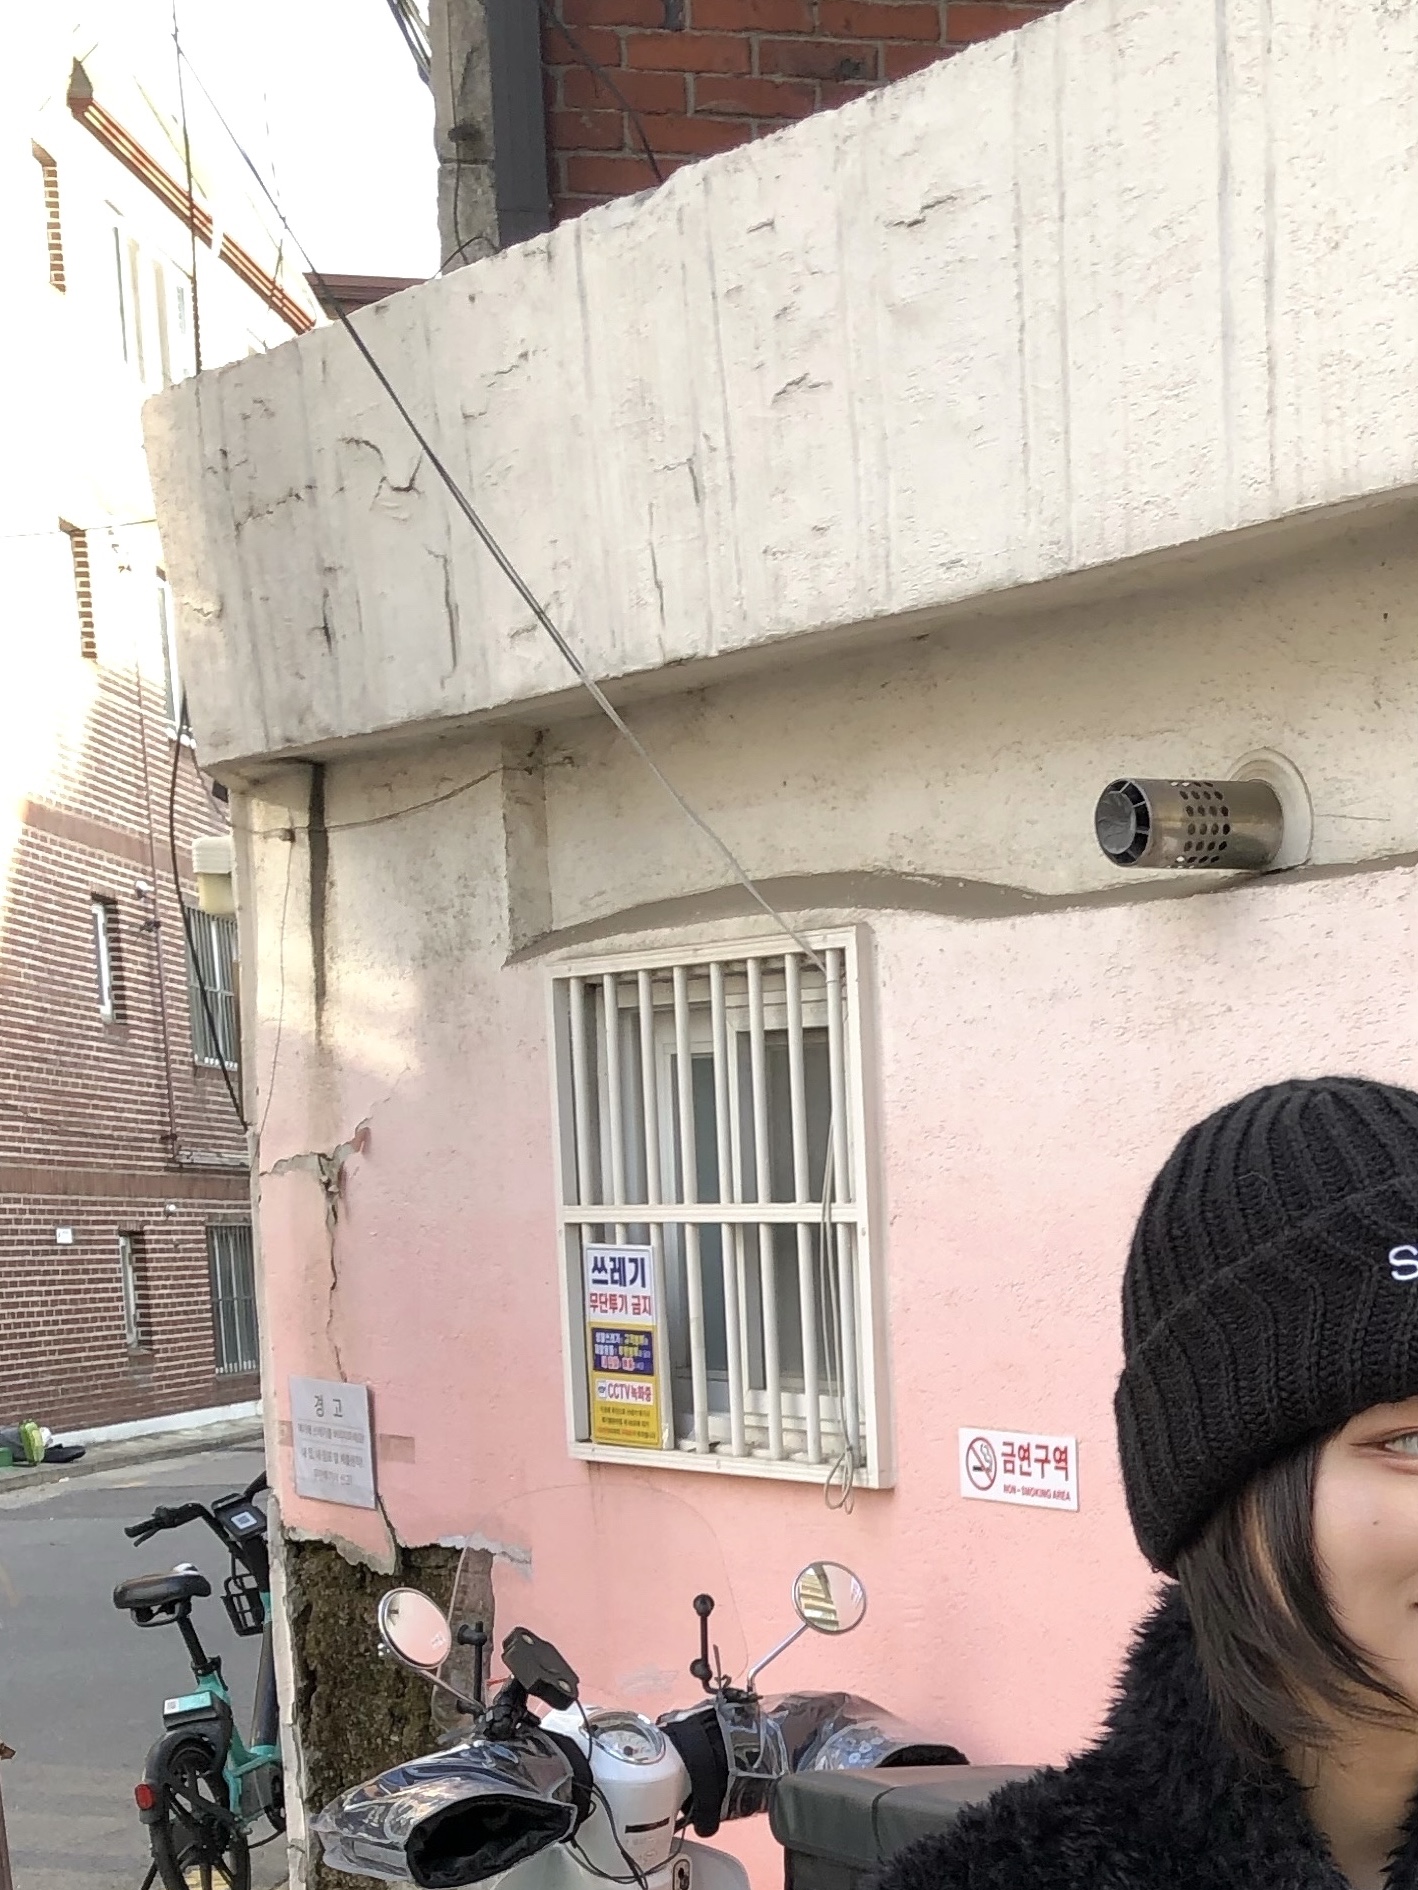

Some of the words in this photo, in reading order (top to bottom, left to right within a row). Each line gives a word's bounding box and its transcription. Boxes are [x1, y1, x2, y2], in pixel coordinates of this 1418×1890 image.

[591, 1255, 646, 1288] 쓰레기
[590, 1292, 628, 1315] 무단투기
[631, 1295, 652, 1316] 금지
[1001, 1441, 1068, 1481] 금연구역
